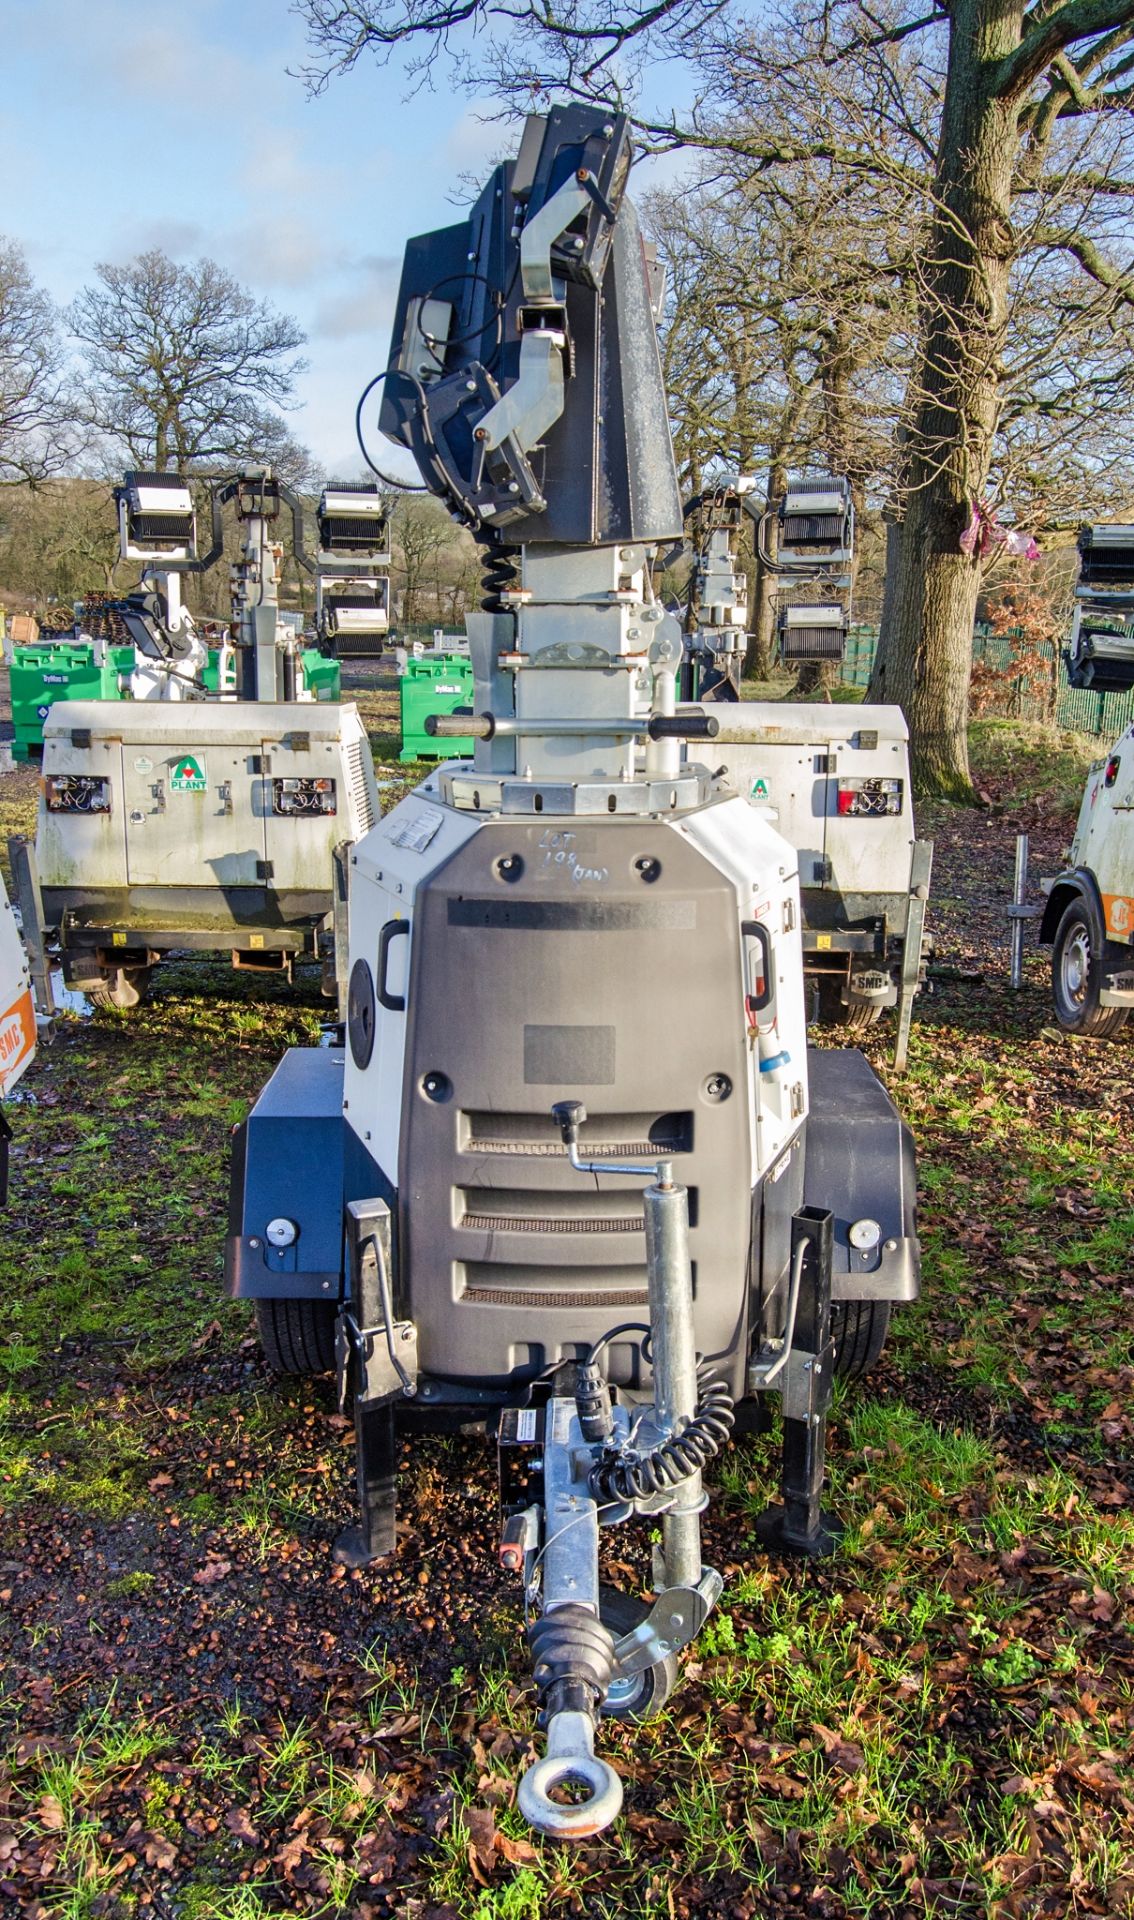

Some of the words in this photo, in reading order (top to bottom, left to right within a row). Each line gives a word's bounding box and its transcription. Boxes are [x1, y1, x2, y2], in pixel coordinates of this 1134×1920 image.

[171, 781, 207, 789] PLANT
[539, 829, 577, 848] LOT
[858, 977, 882, 989] SMC
[1117, 978, 1134, 991] SM
[0, 1023, 20, 1061] SMC
